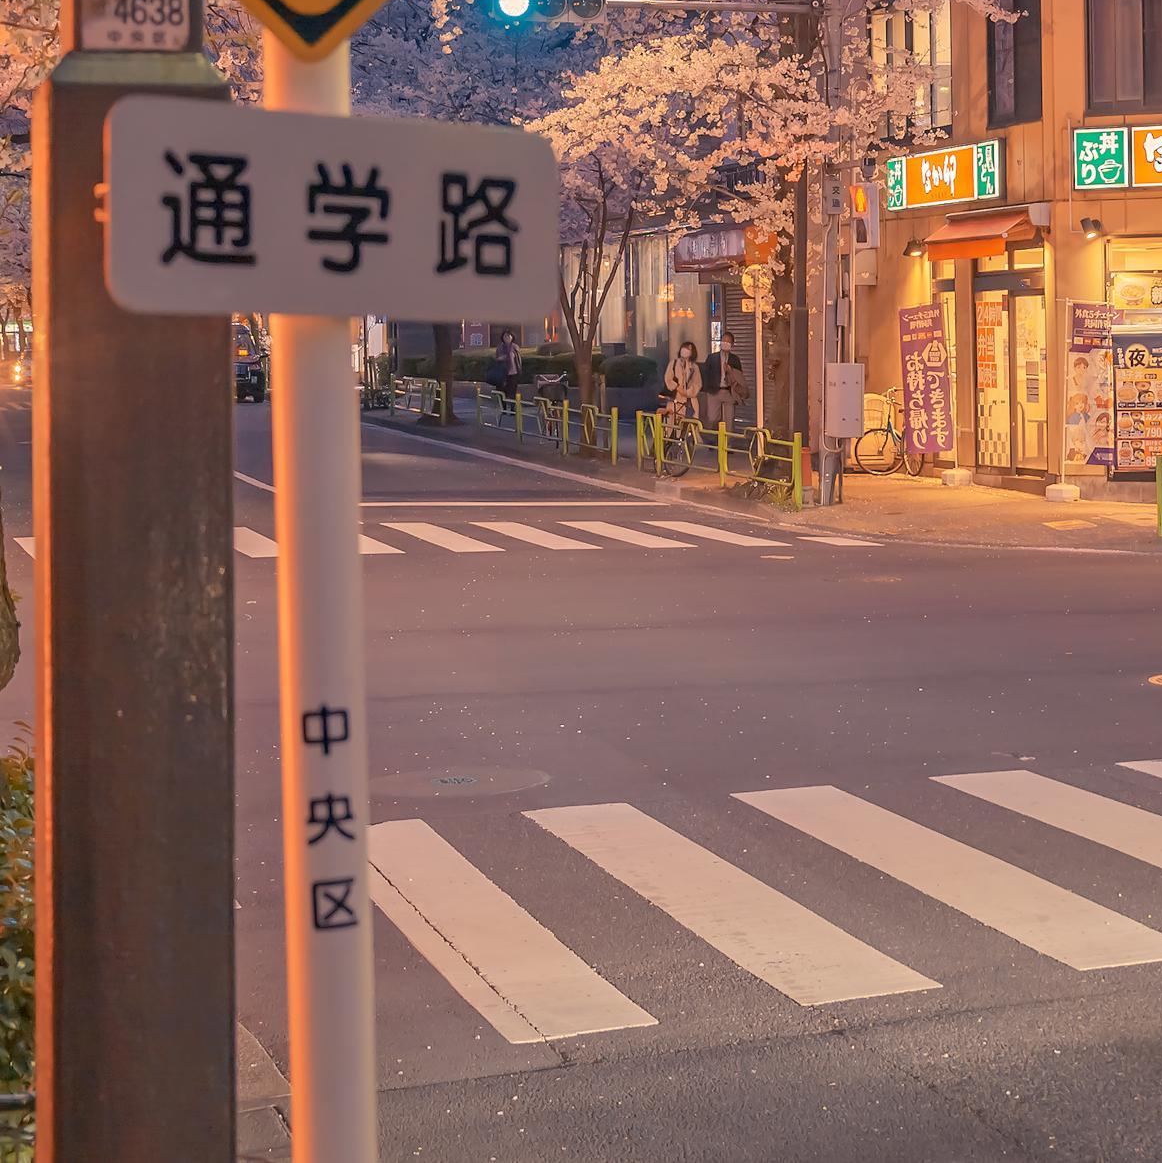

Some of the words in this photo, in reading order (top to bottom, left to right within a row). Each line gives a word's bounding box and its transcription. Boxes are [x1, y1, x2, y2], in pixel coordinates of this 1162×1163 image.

[160, 149, 521, 276] 通学路
[921, 154, 957, 197] なか卯
[302, 702, 358, 931] 中央区
